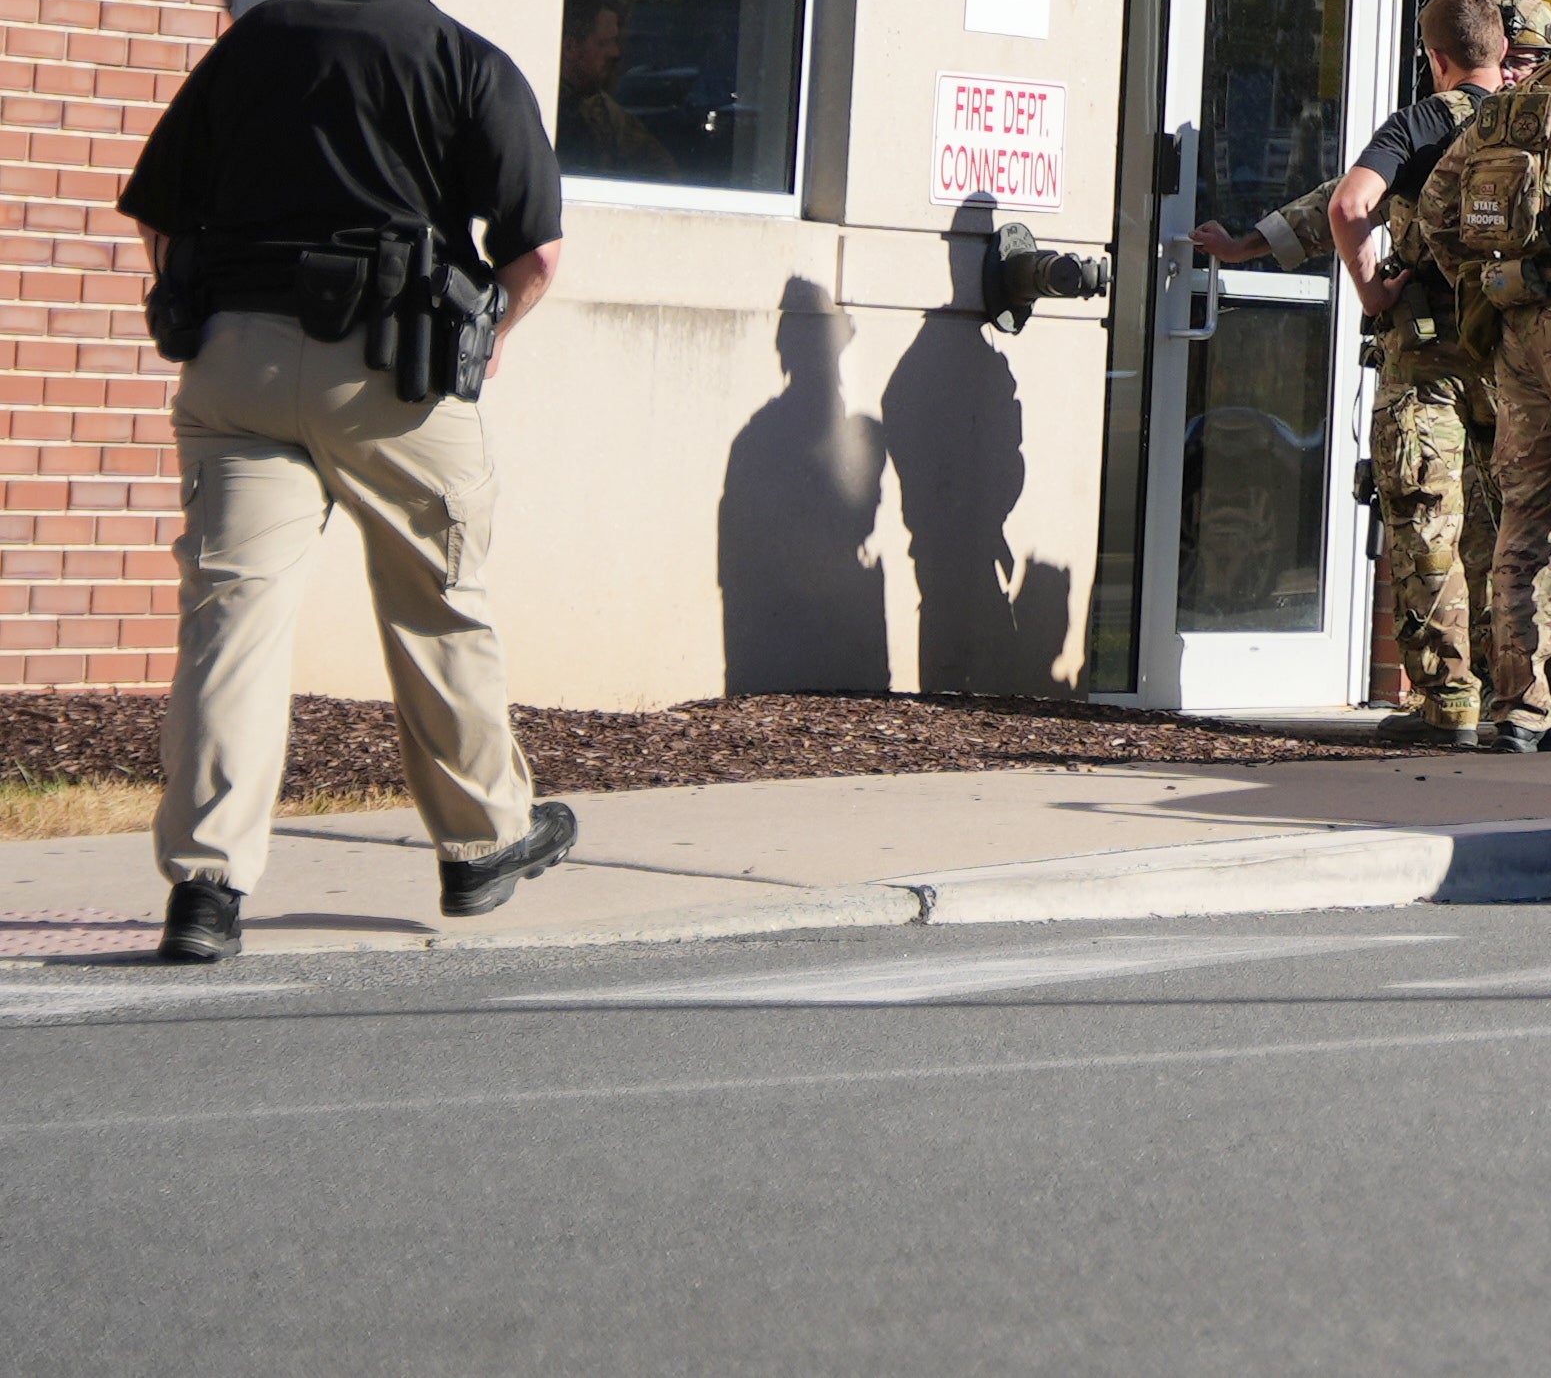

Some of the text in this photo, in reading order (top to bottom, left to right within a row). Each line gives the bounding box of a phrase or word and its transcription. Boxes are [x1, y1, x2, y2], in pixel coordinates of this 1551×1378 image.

[955, 86, 1049, 137] FIRE DEPT.
[941, 144, 1058, 197] CONNECTION
[1466, 213, 1506, 226] TROOPER
[1473, 200, 1499, 212] STATE
